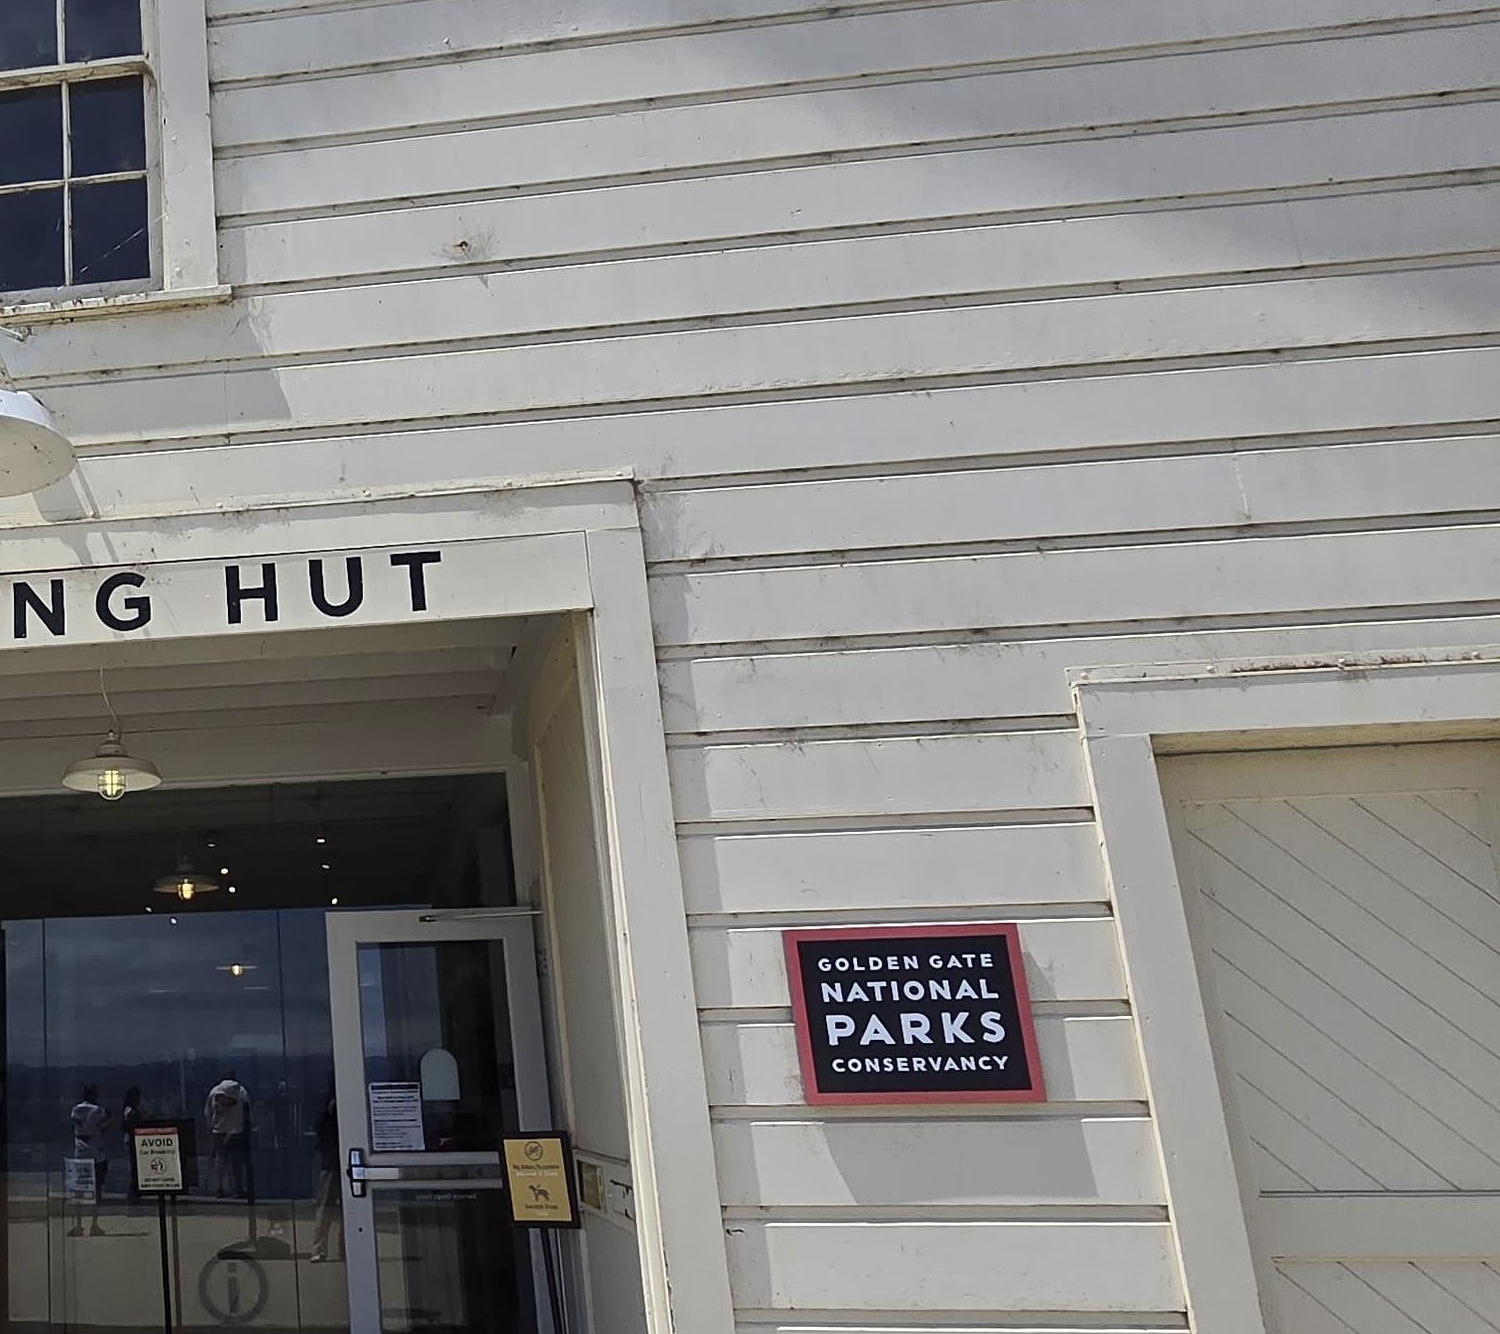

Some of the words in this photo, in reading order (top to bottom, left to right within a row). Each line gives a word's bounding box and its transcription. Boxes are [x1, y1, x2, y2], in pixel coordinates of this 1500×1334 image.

[225, 551, 442, 624] HUT
[817, 954, 919, 972] GOLDEN
[929, 953, 994, 968] GATE
[820, 978, 999, 1003] NATIONAL
[825, 1011, 1006, 1046] PARKS
[832, 1055, 1009, 1073] CONSERVANCY
[141, 1138, 173, 1147] AVOID
